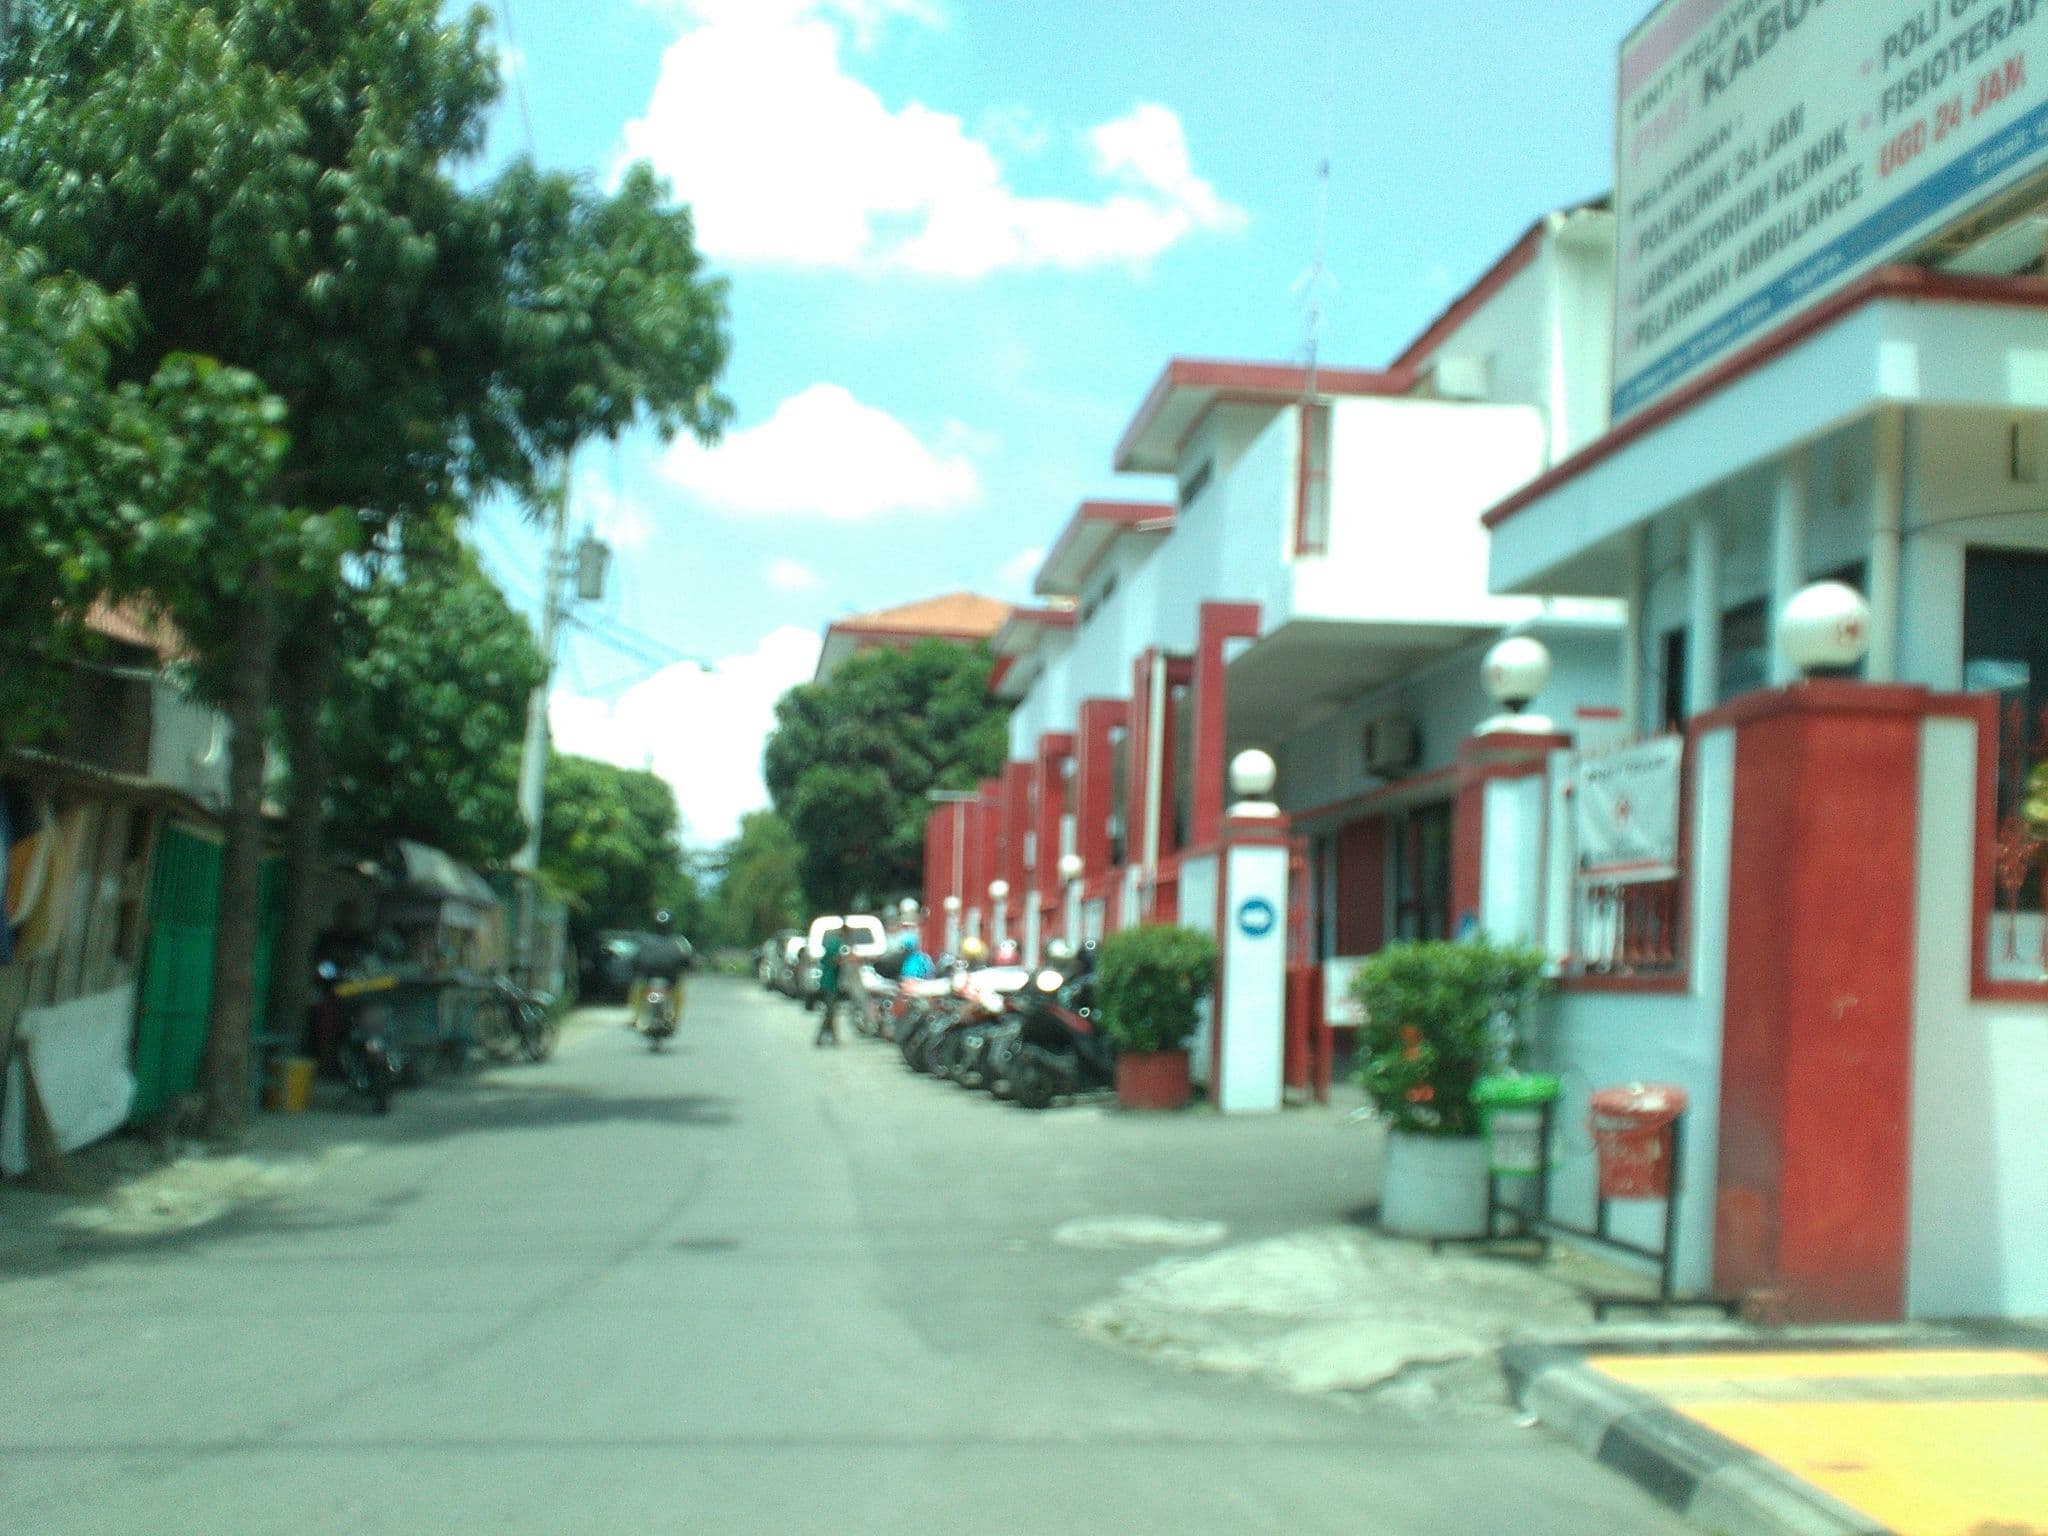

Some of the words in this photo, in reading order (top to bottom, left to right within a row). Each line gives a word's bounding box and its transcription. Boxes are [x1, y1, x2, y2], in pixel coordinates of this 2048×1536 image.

[1681, 0, 1761, 77] PELAYA
[1701, 0, 1824, 107] KABU
[1638, 162, 1731, 255] POLIKLINIK
[1763, 101, 1805, 161] JAM
[1878, 117, 1926, 178] UGD
[1933, 93, 1962, 144] 24
[1971, 50, 2026, 118] JAM
[1635, 259, 1732, 346] PELAYANAN
[1735, 164, 1864, 280] AMBULANCE
[1636, 180, 1770, 310] LABORATORIUM
[1773, 120, 1850, 202] KLINIK
